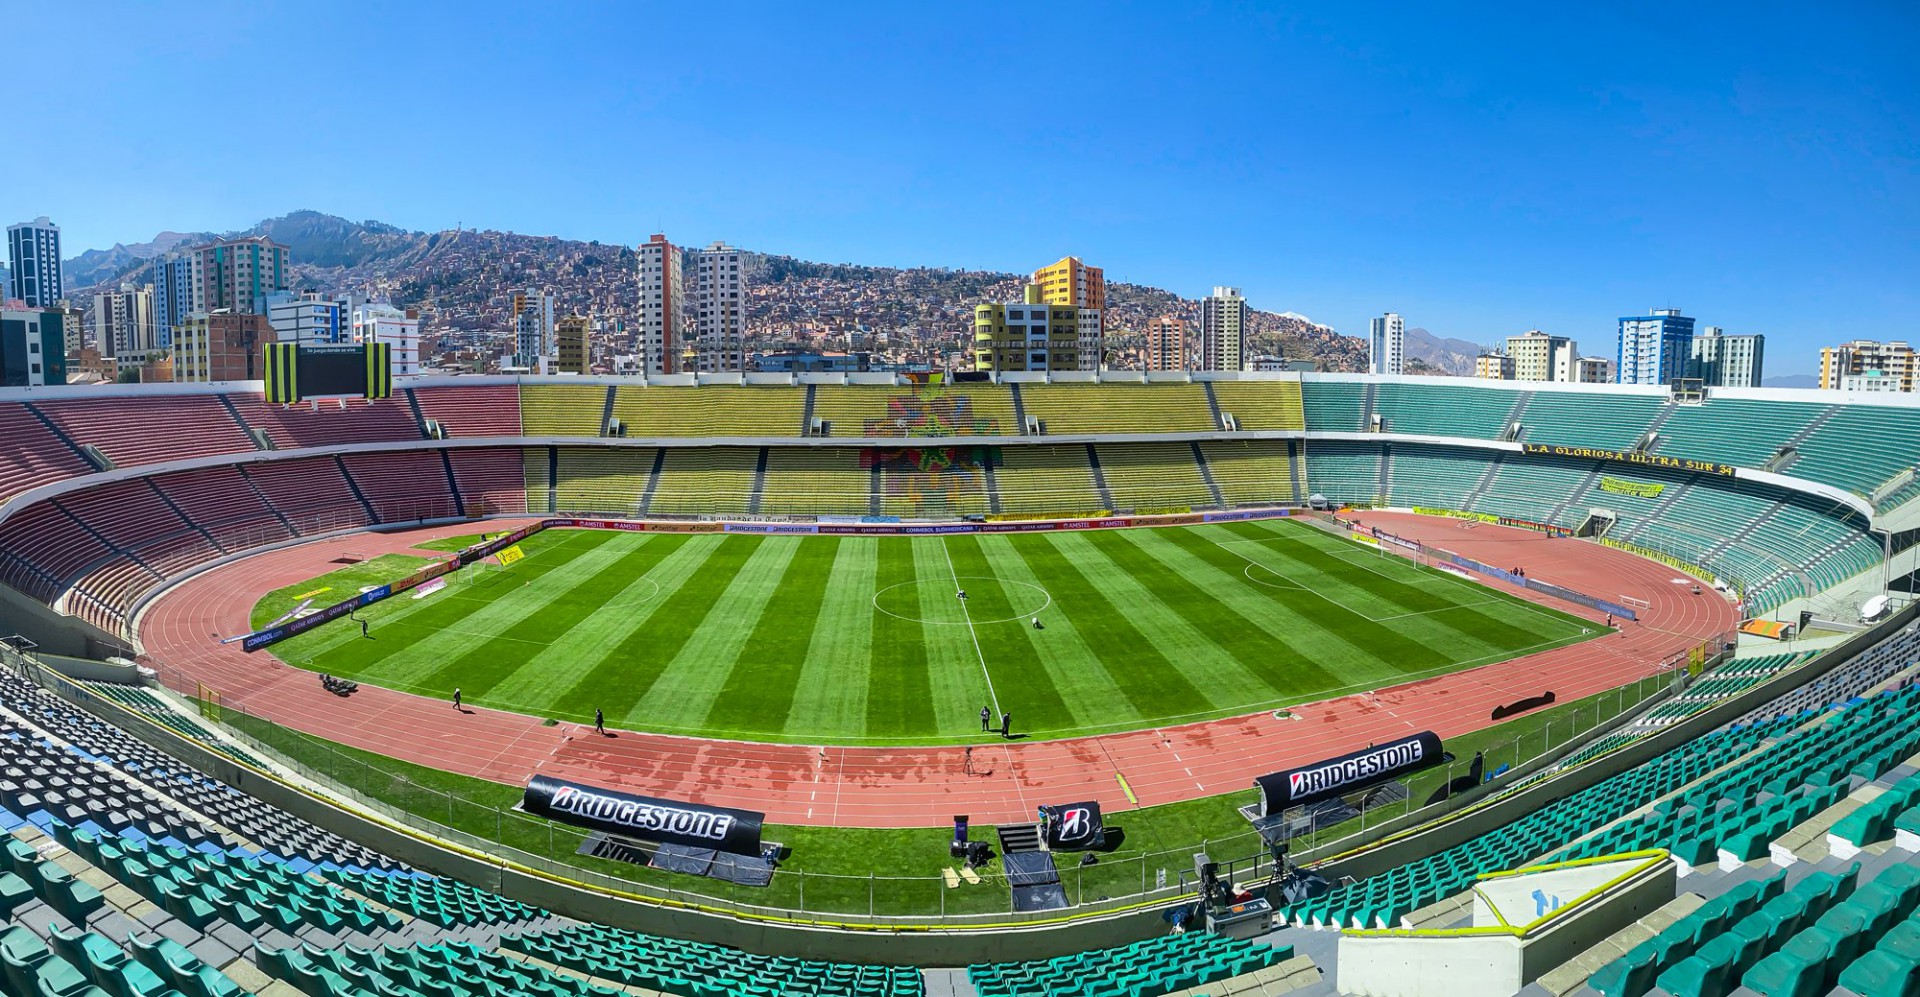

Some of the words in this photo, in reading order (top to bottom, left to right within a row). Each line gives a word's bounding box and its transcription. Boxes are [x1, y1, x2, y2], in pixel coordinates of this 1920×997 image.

[1528, 445, 1550, 453] LA
[1555, 447, 1625, 461] GLORIOSA
[1630, 454, 1681, 467] ULTRA
[1686, 461, 1714, 472] SUR
[1291, 741, 1421, 798] BRIDGESTONE
[552, 787, 731, 839] BRIDGESTONE
